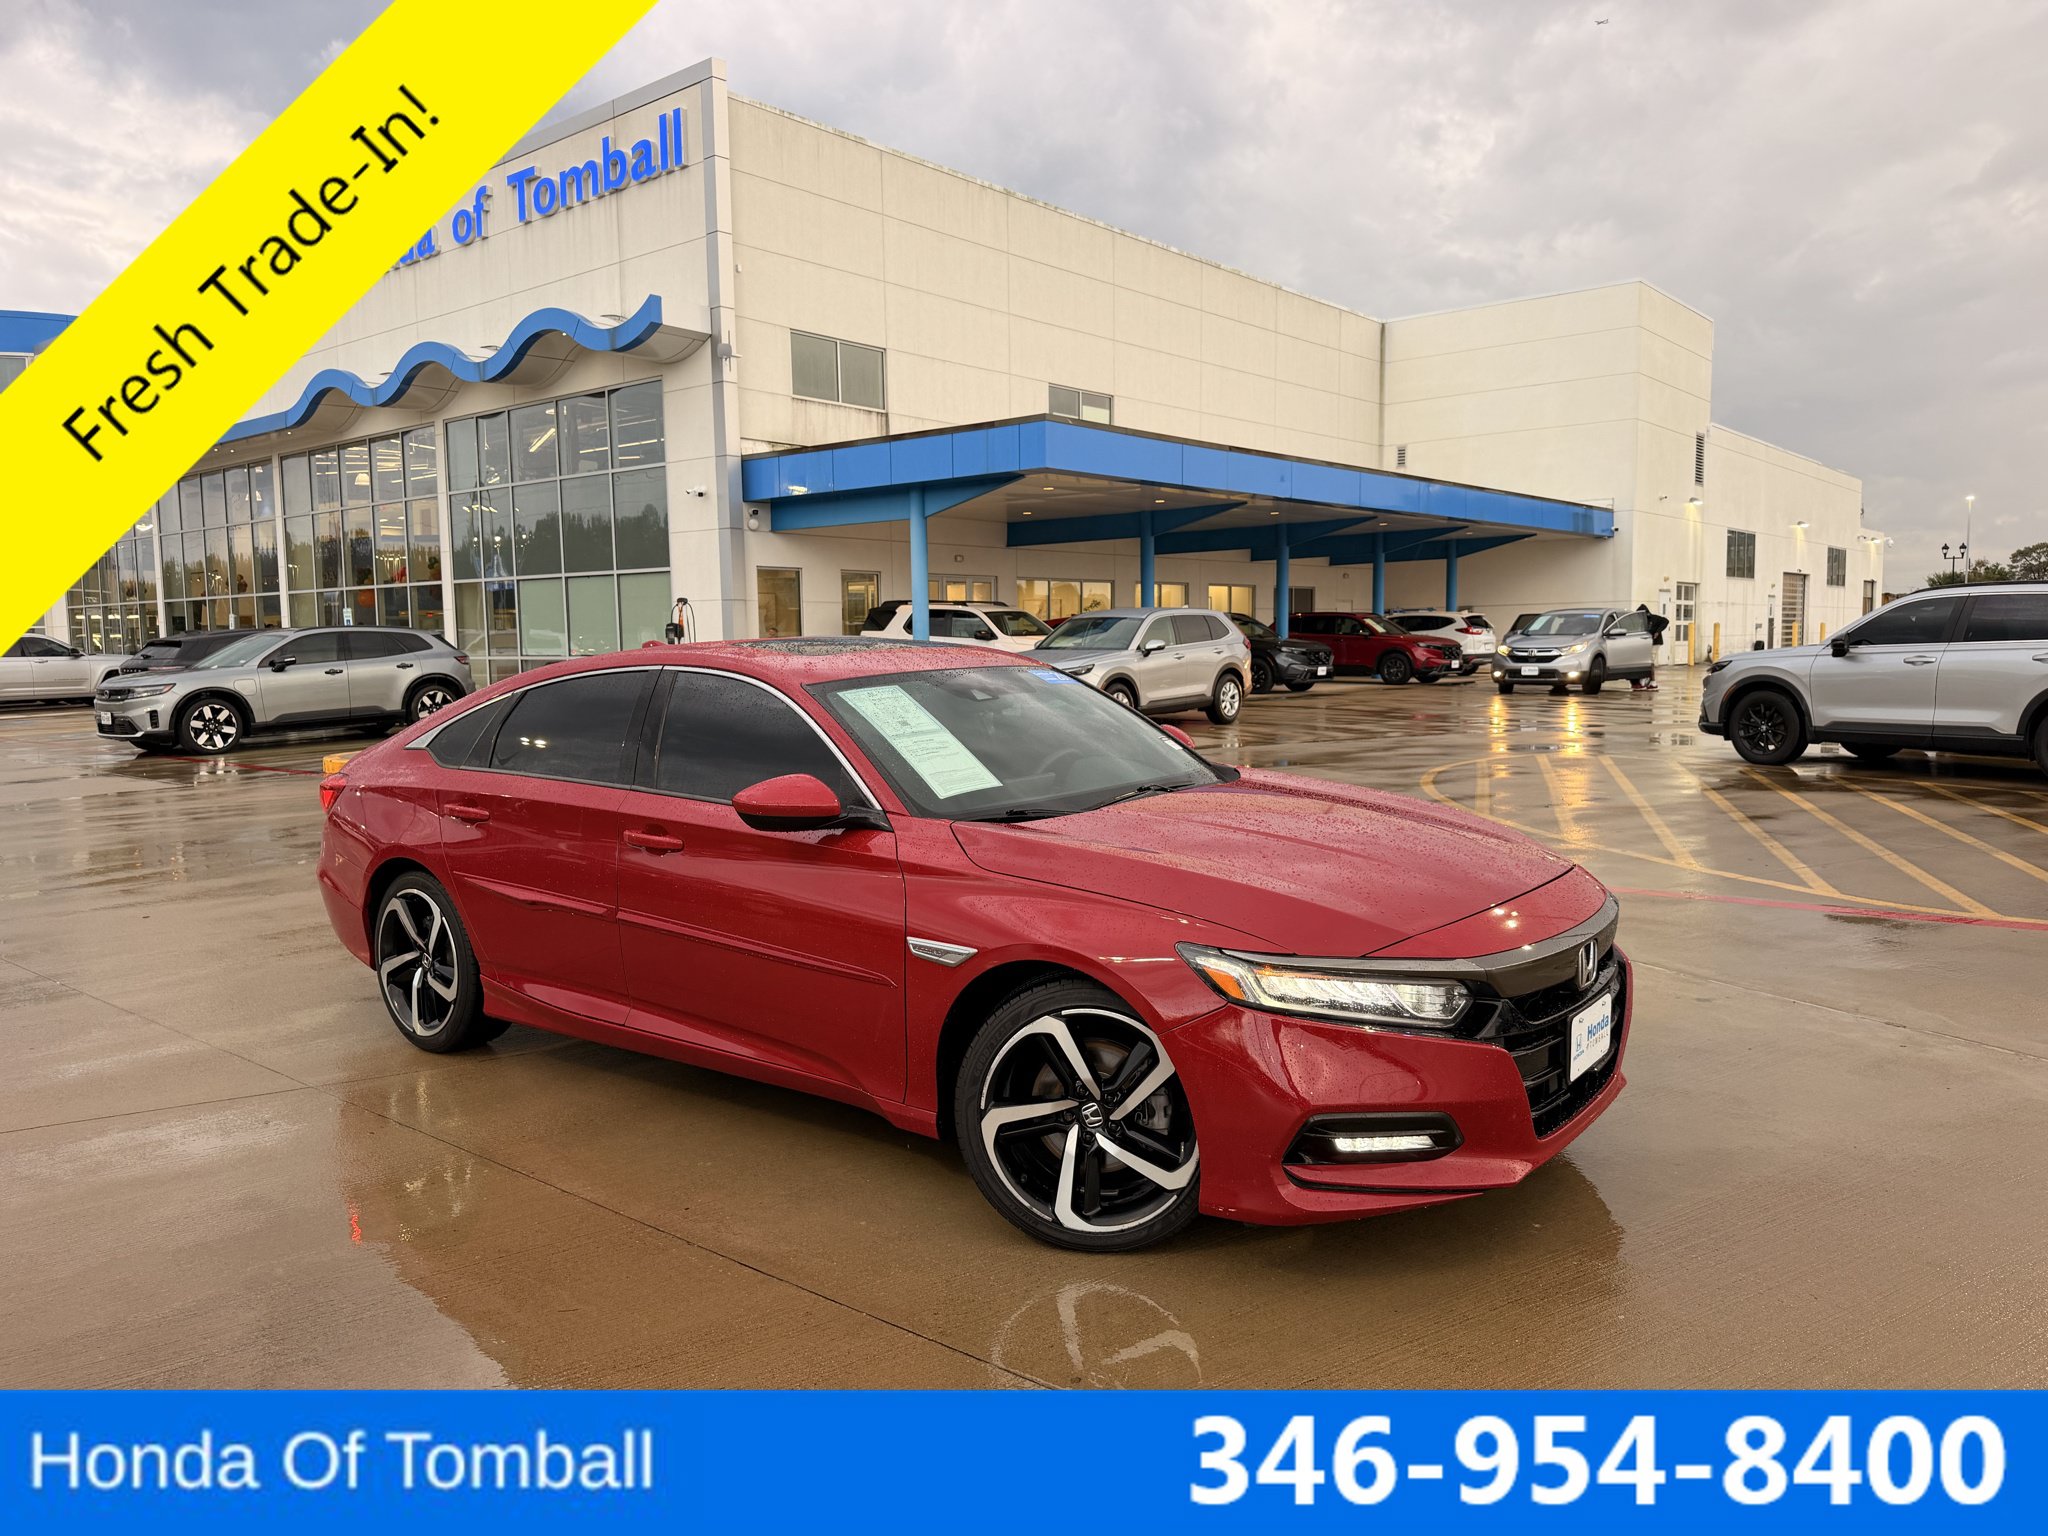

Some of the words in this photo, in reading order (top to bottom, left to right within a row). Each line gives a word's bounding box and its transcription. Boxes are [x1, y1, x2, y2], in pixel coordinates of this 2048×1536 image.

[451, 185, 492, 245] of
[507, 107, 686, 223] Tomball
[1587, 1014, 1609, 1041] Honda
